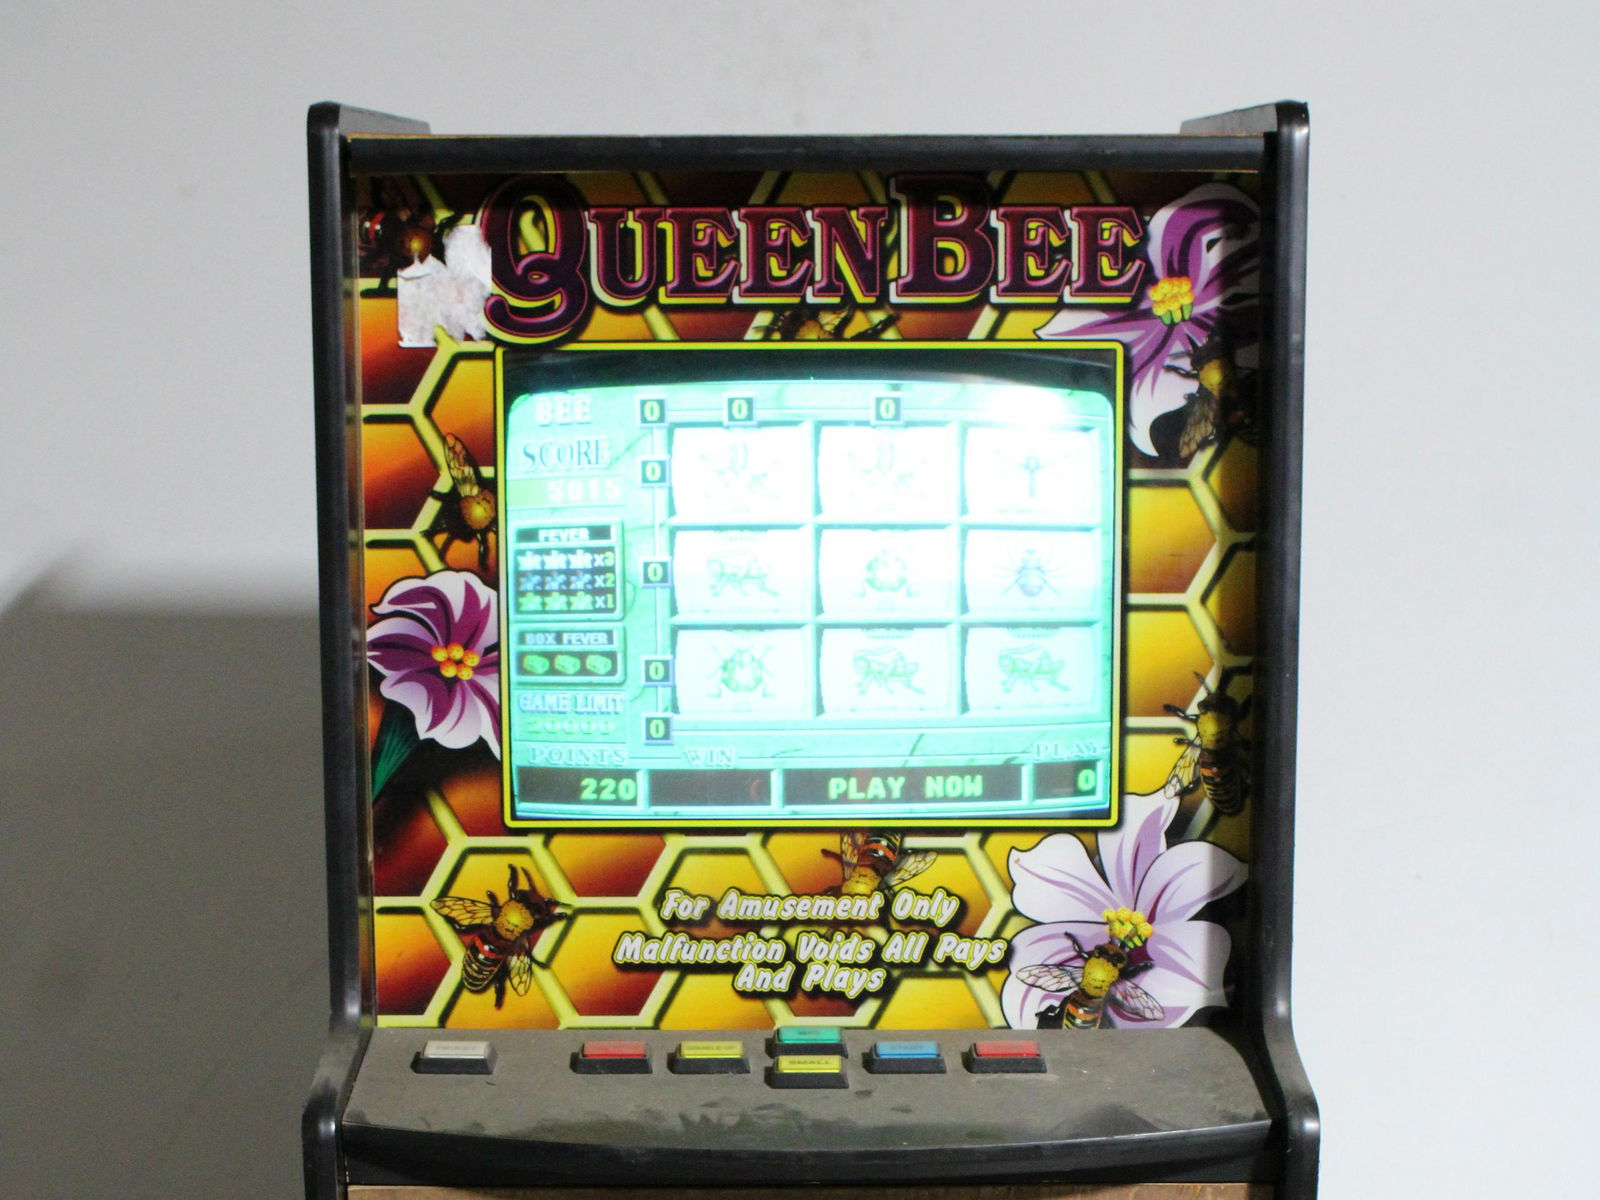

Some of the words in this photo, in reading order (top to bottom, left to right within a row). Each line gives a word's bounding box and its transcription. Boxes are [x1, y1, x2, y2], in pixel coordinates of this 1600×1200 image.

[482, 174, 888, 344] QUEEN
[889, 174, 1146, 304] BEE
[644, 400, 660, 421] 0
[732, 398, 748, 420] 0
[879, 398, 896, 420] 0
[522, 437, 610, 470] SCORE
[646, 461, 662, 481] 0
[538, 527, 590, 542] FEVER
[647, 562, 663, 582] 0
[525, 633, 556, 645] BOX
[563, 633, 608, 645] FEVER
[649, 661, 664, 681] 0
[519, 692, 569, 713] GAME
[574, 692, 624, 715] LIMIT
[650, 718, 665, 738] 0
[529, 746, 628, 767] POINTS
[684, 748, 735, 767] WIN
[580, 778, 637, 800] 220
[828, 776, 905, 800] PLAY
[925, 775, 983, 798] NOW
[1077, 769, 1096, 792] 0
[662, 890, 708, 922] For
[718, 889, 884, 922] Amusement
[893, 888, 959, 927] Only
[615, 932, 787, 965] Malfunction
[796, 932, 876, 964] Voids
[883, 932, 929, 964] All
[935, 934, 1007, 969] Pays
[735, 963, 794, 994] And
[803, 965, 886, 998] Plays
